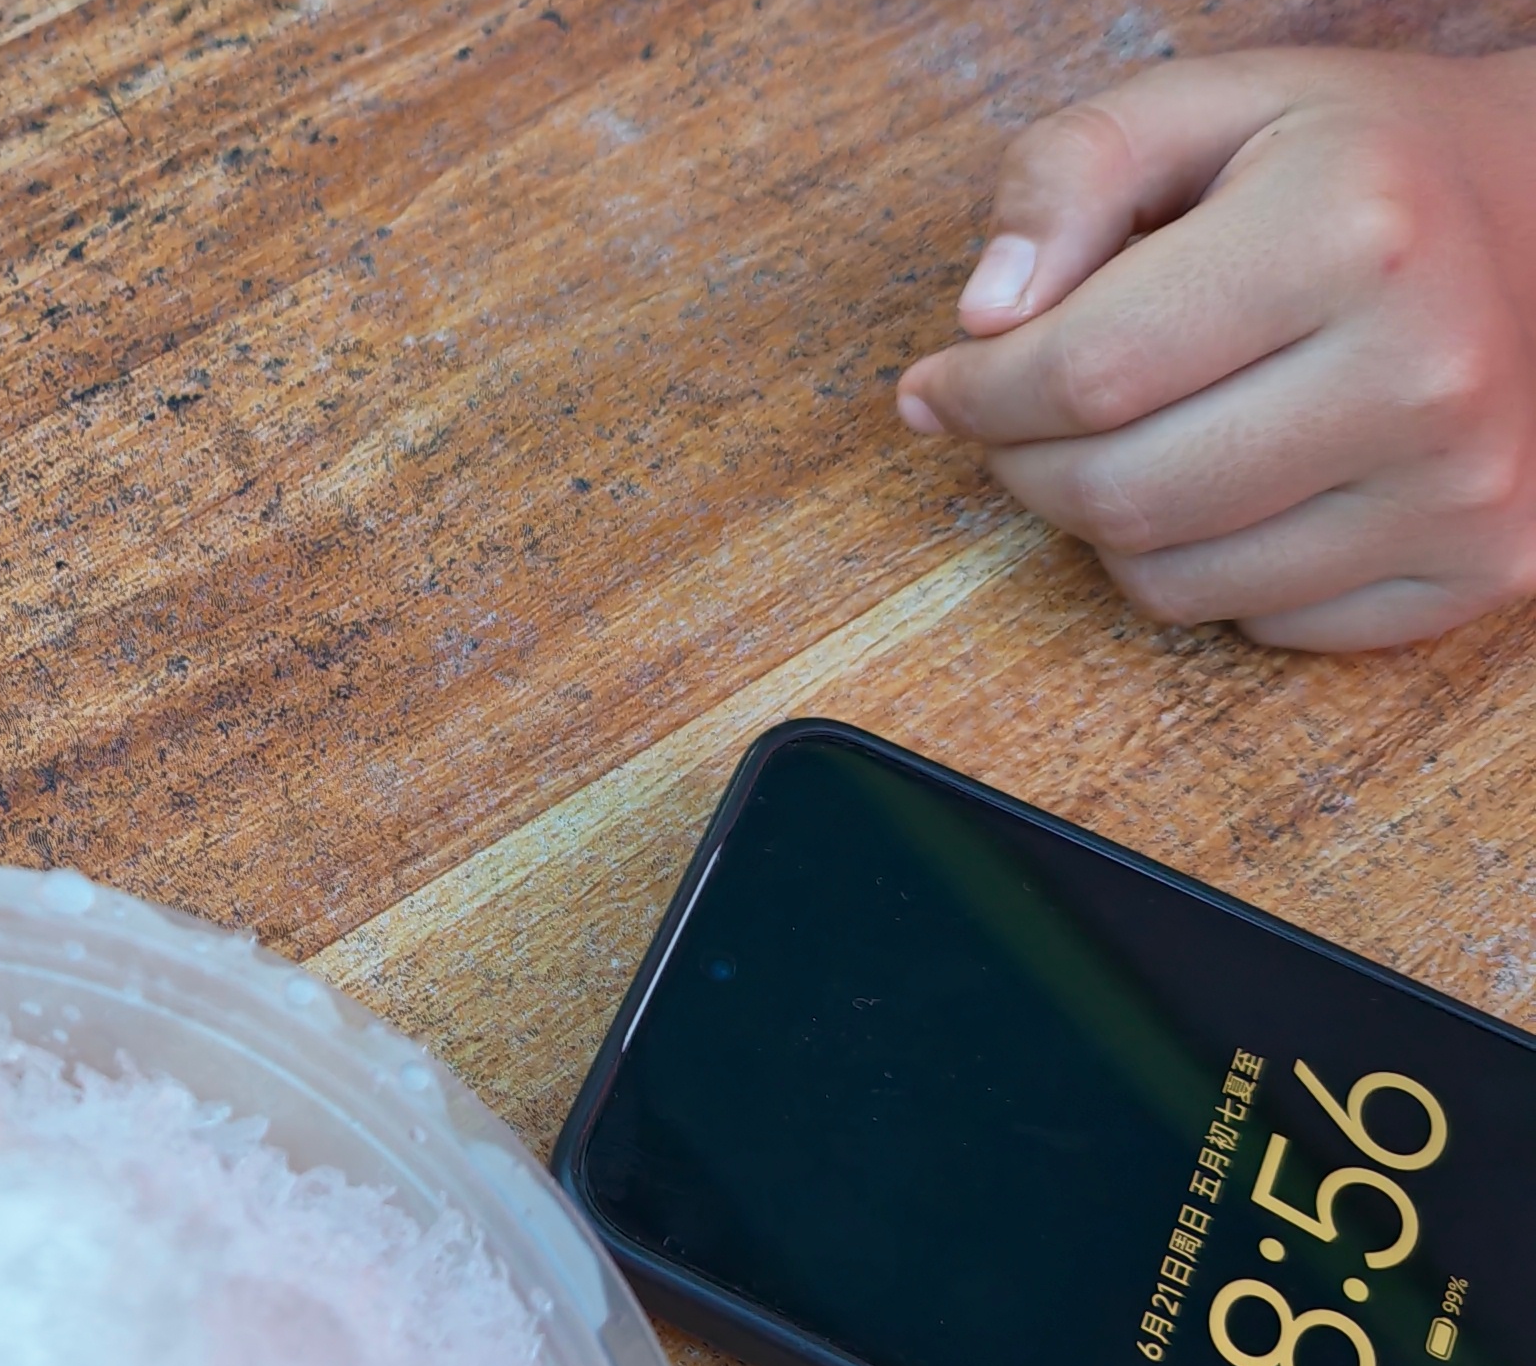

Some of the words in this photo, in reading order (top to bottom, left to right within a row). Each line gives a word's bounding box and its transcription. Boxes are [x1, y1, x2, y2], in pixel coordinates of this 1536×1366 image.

[1136, 1203, 1213, 1362] 6月21日周日
[1190, 1047, 1264, 1204] 五月初七夏至
[1442, 1275, 1469, 1316] 99%
